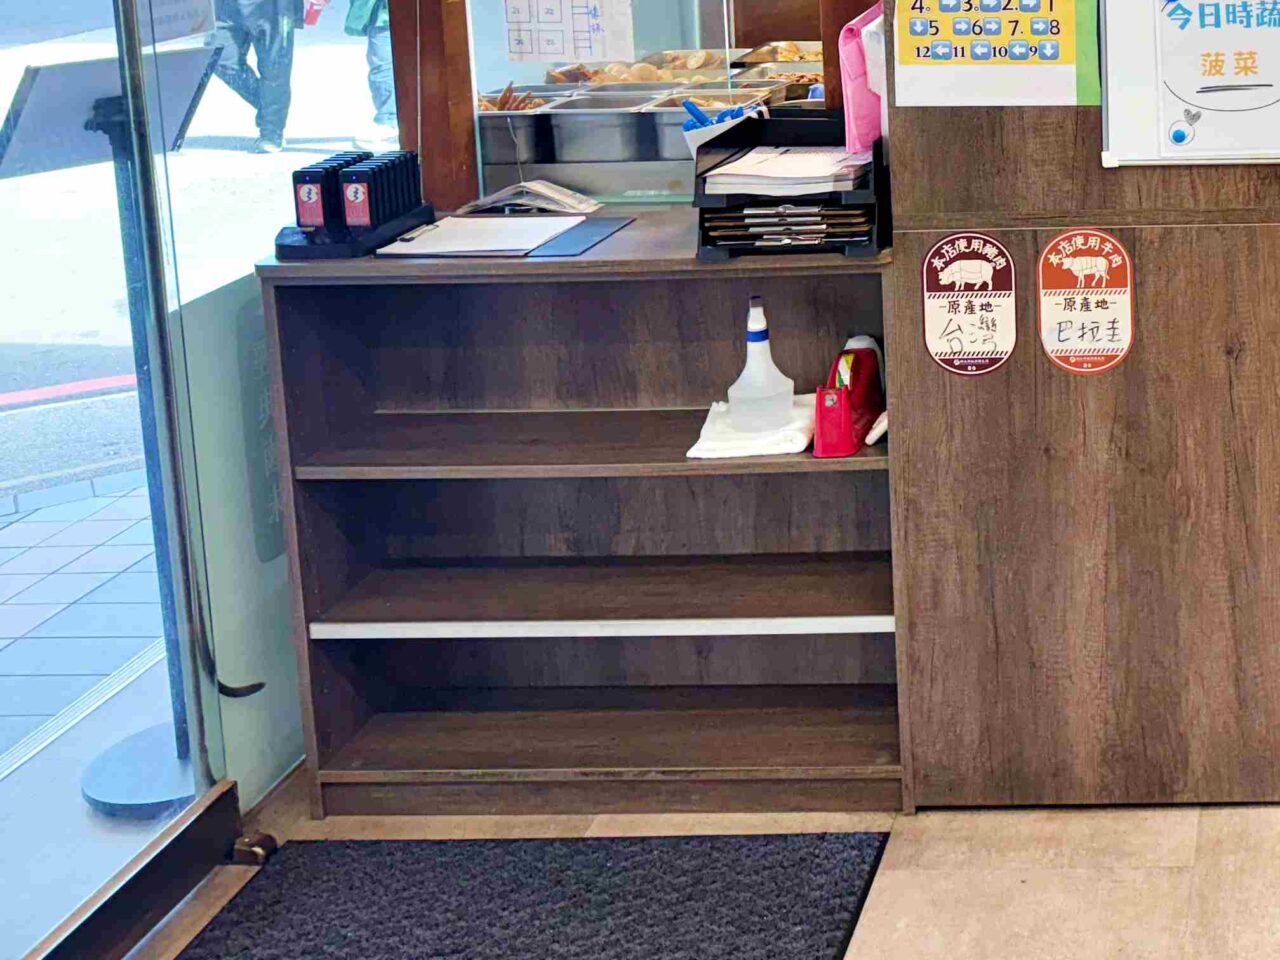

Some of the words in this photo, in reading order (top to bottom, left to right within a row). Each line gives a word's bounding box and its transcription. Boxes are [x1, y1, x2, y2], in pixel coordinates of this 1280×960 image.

[928, 20, 940, 36] 5
[972, 20, 983, 36] 6
[1049, 20, 1060, 36] 8
[915, 46, 931, 58] 12
[953, 46, 965, 58] 11
[992, 46, 1008, 58] 10
[1029, 46, 1038, 59] 9
[1201, 51, 1258, 77] 菠菜
[930, 239, 1007, 272] 本店使用豬肉
[1047, 236, 1123, 268] 本店使用牛肉
[947, 300, 994, 315] 原產地
[1063, 297, 1109, 312] 原產地
[939, 314, 997, 355] 台灣
[1056, 318, 1122, 343] 巴拉圭
